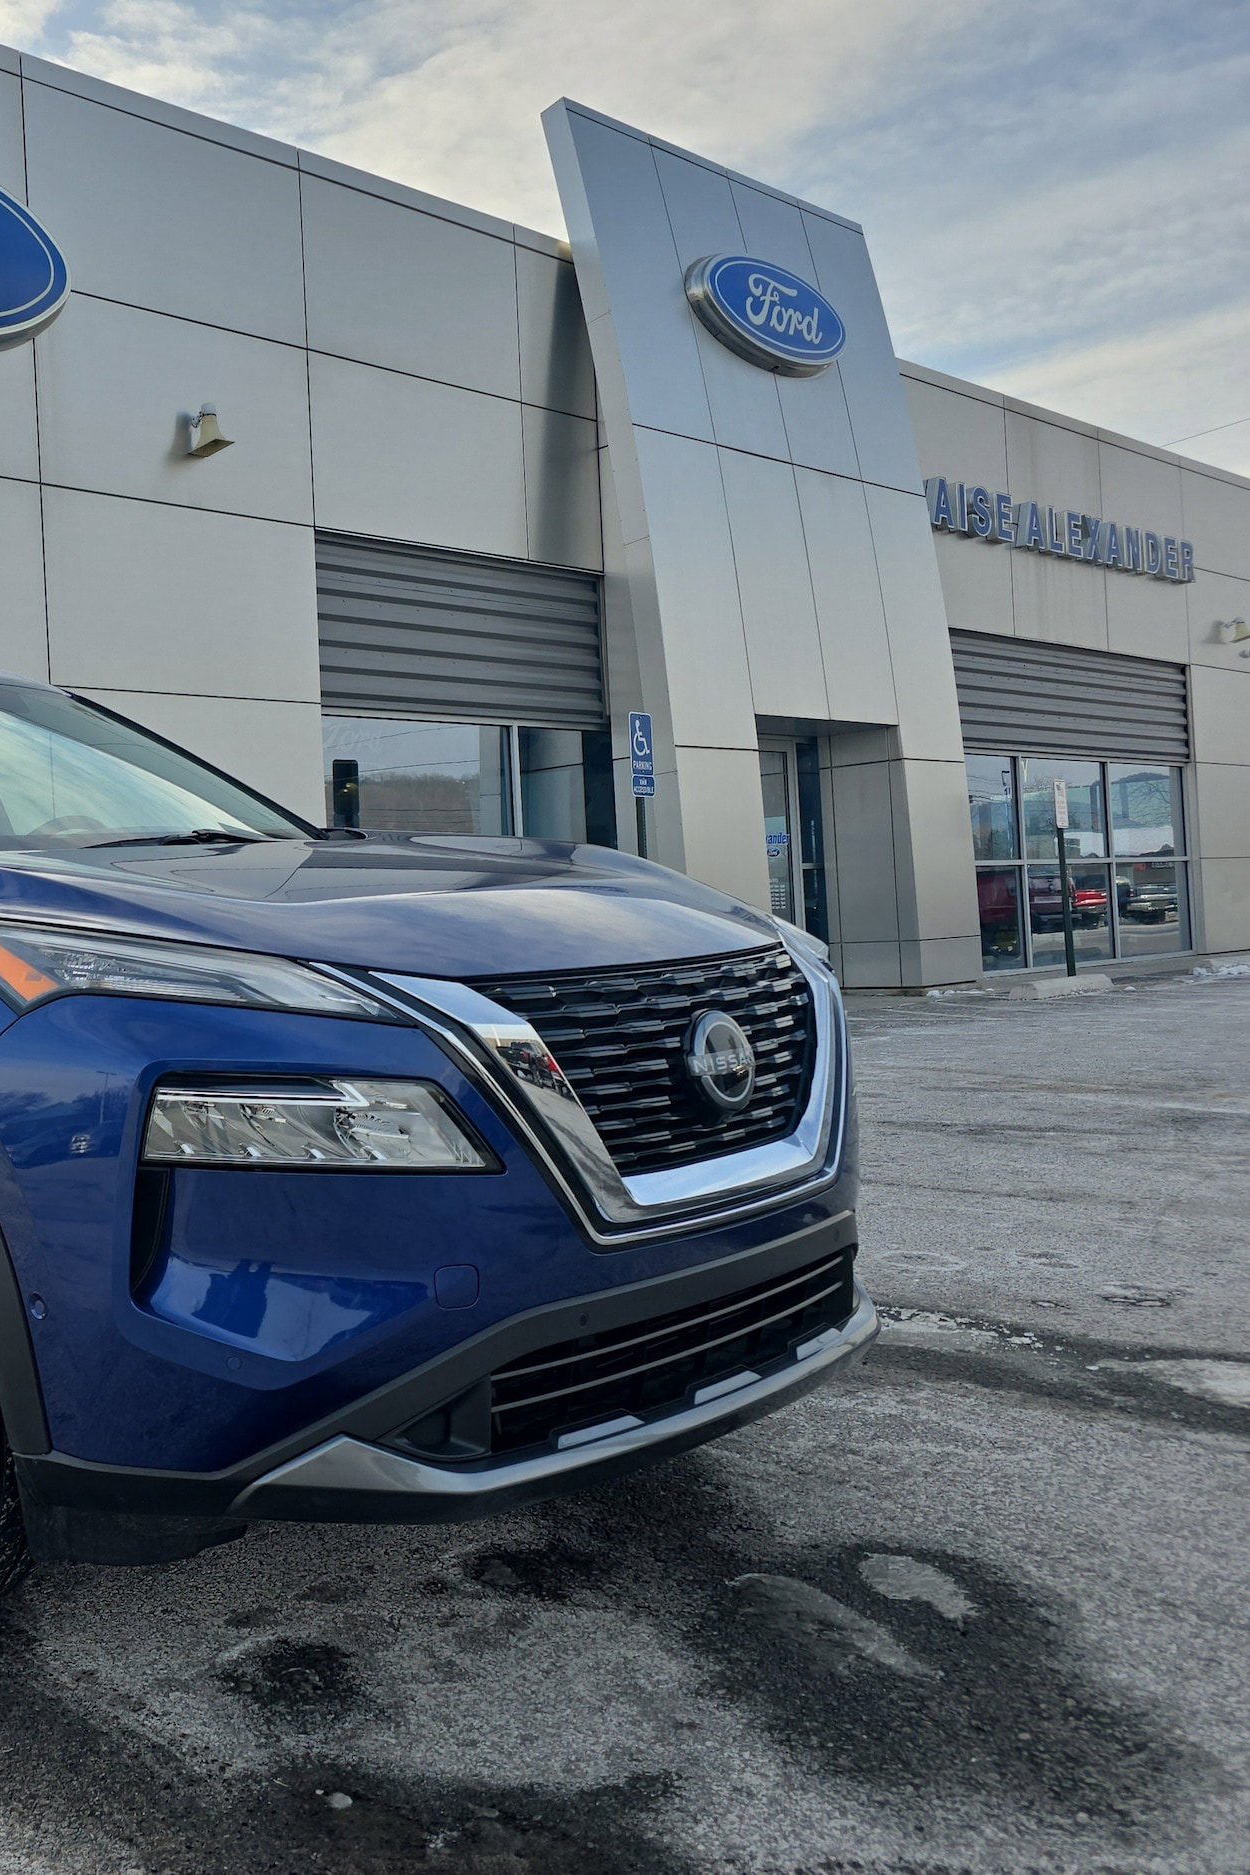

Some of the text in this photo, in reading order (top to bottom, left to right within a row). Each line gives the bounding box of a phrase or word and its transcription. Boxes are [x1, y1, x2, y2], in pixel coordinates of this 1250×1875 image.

[745, 273, 823, 345] Ford
[932, 476, 1197, 584] AISE ALEXANDER
[632, 760, 653, 771] PARKING
[693, 1050, 756, 1074] NISSAN
